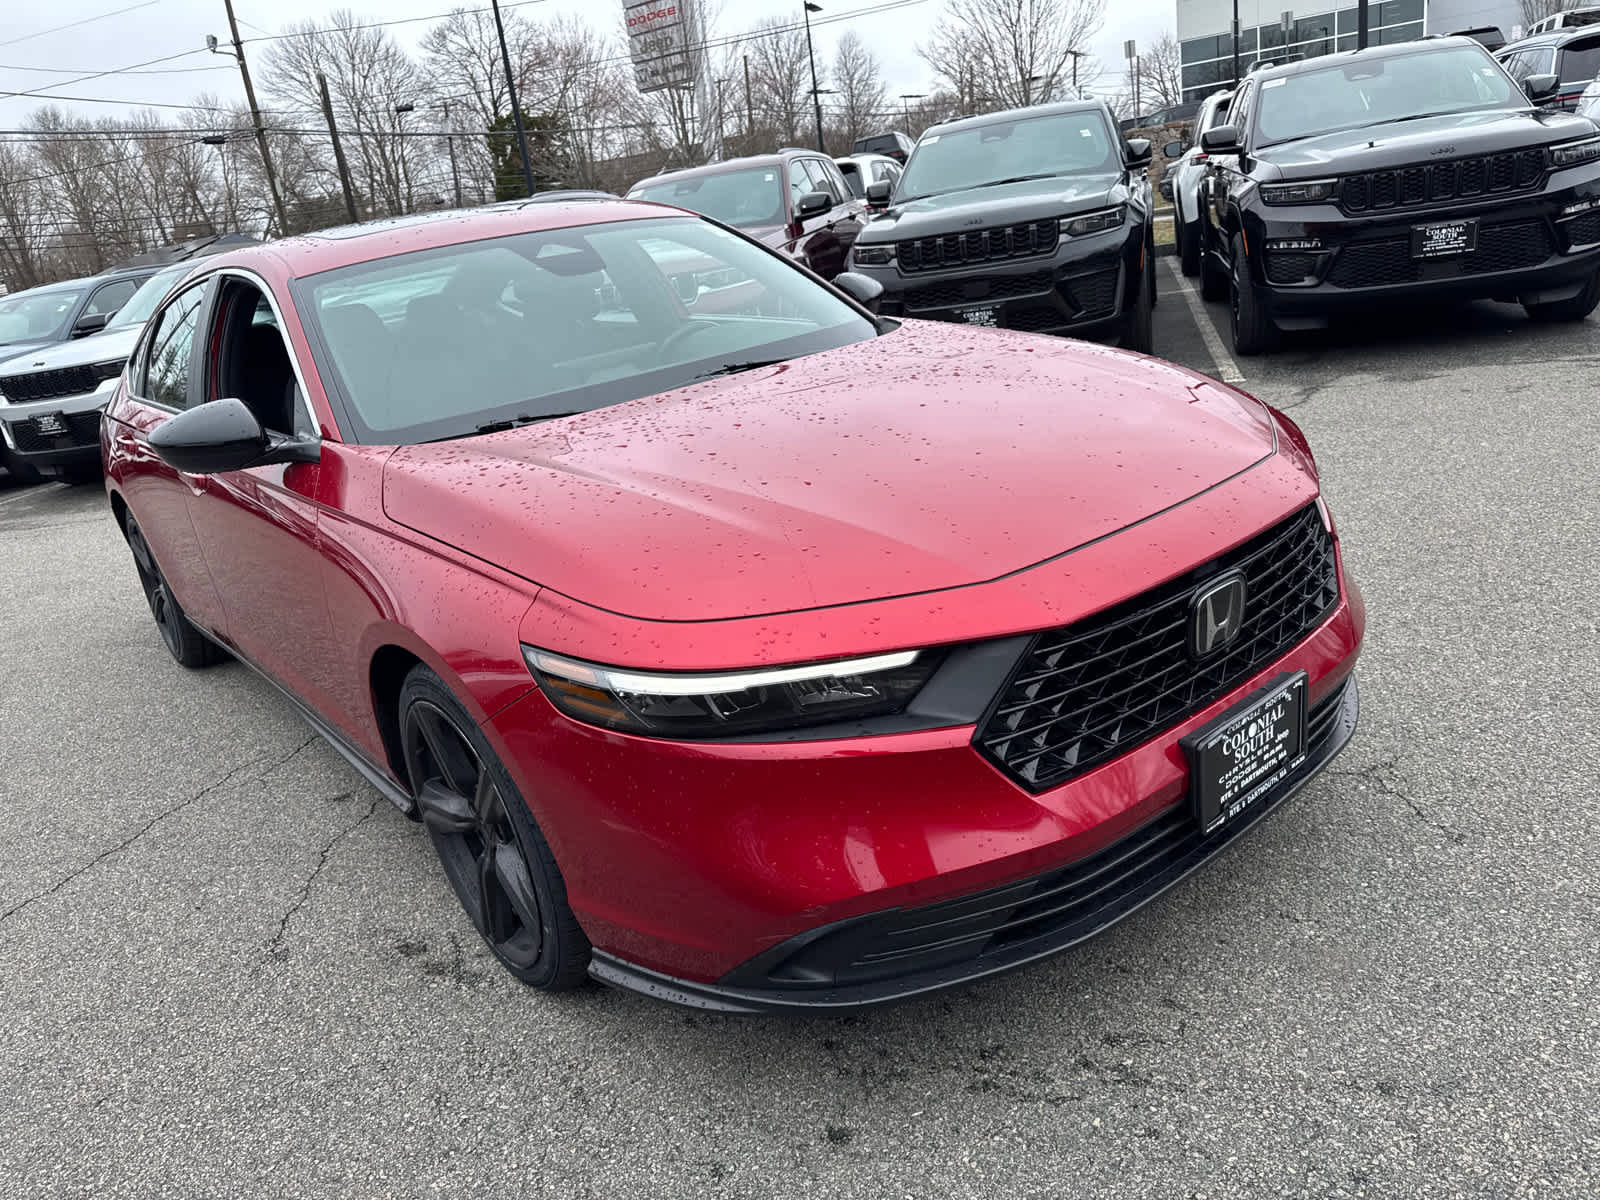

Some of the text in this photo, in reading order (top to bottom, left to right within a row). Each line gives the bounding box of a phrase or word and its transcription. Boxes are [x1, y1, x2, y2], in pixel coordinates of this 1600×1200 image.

[628, 6, 676, 27] DODGE
[640, 35, 673, 54] Jeep
[1222, 704, 1285, 756] COLONIAL
[1234, 725, 1274, 763] SOUTH
[1218, 744, 1270, 784] CHRYSLER
[1225, 761, 1258, 789] DODGE
